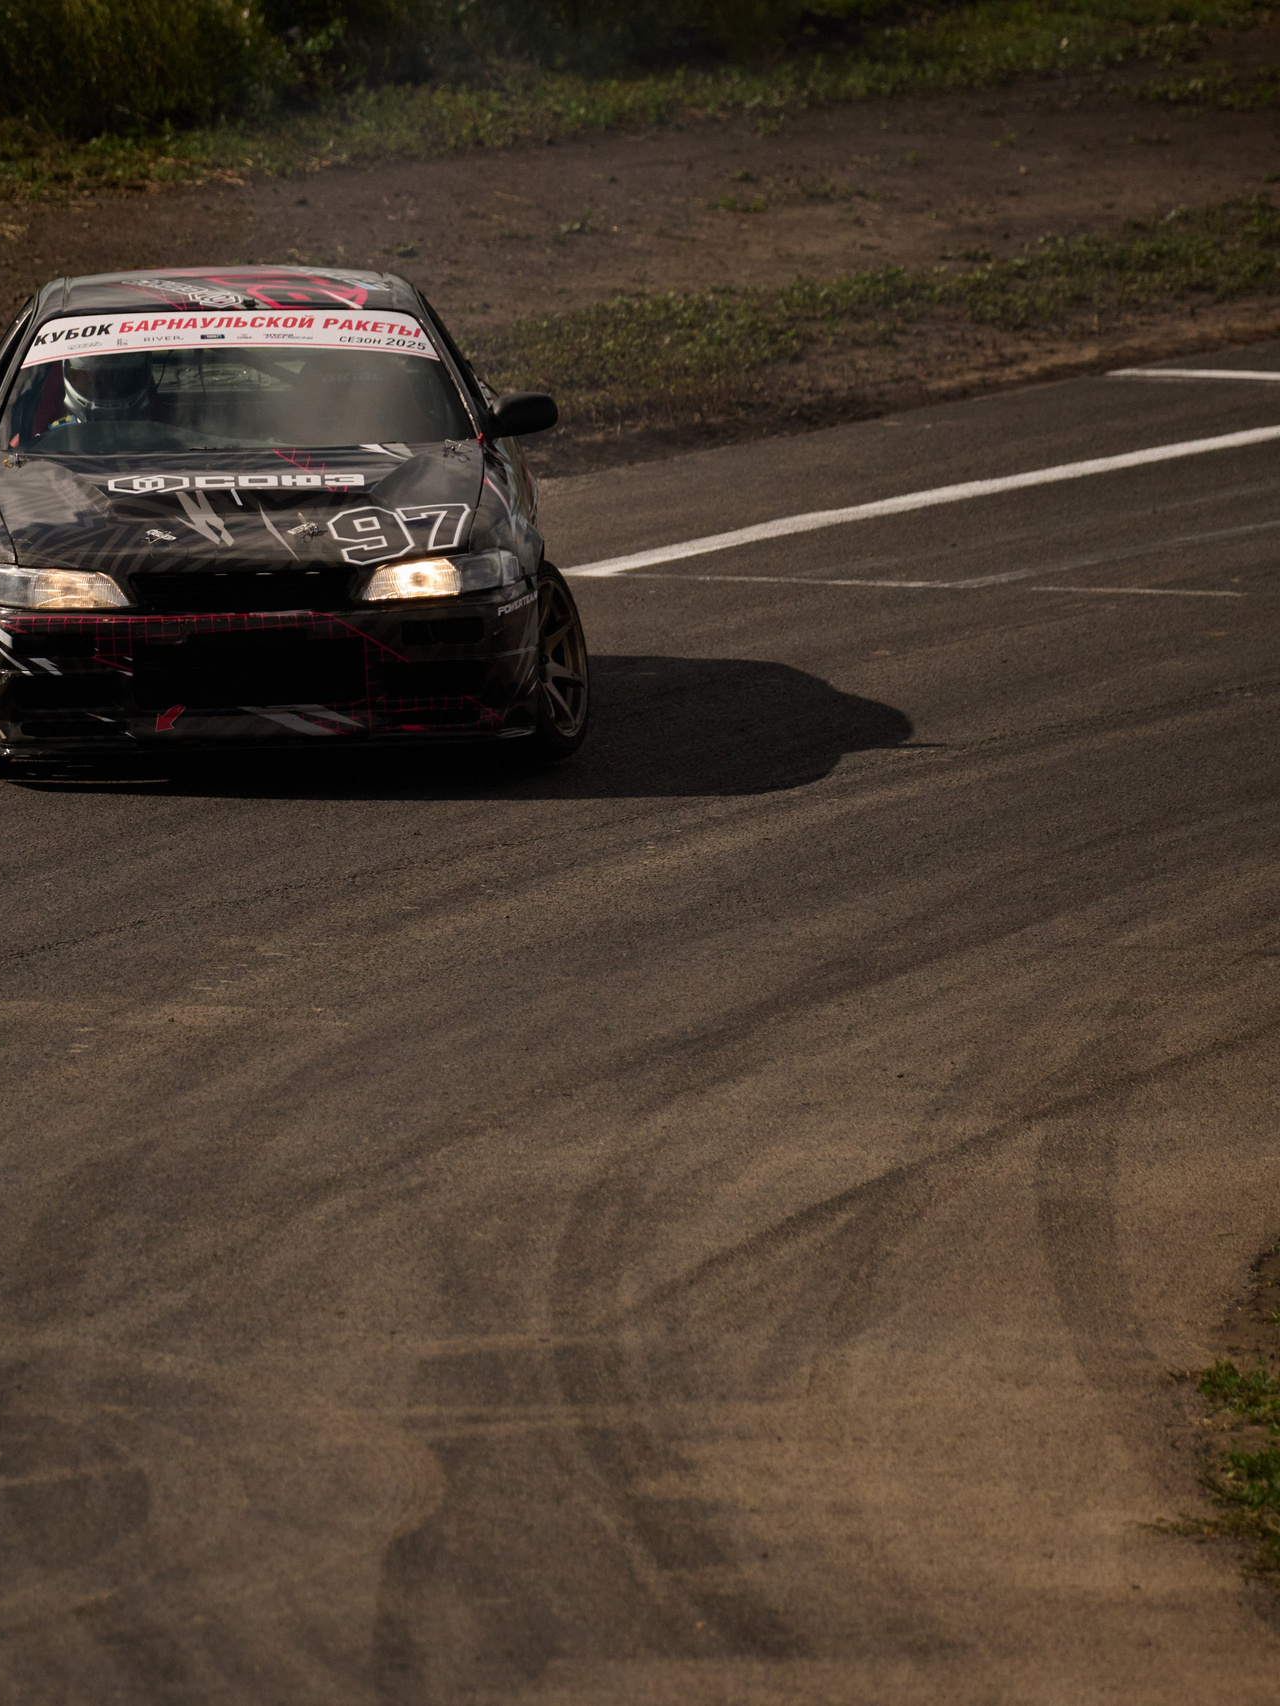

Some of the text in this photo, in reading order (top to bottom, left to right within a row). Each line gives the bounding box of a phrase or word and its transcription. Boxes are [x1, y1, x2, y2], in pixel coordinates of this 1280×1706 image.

[34, 322, 114, 347] КУБОК
[119, 314, 315, 334] БАРНАУЛЬСКОЙ
[322, 317, 421, 338] РАКЕТЫ
[339, 335, 426, 350] СЕЗОН 2025
[195, 473, 365, 488] СОЮЗ
[326, 503, 471, 565] 97
